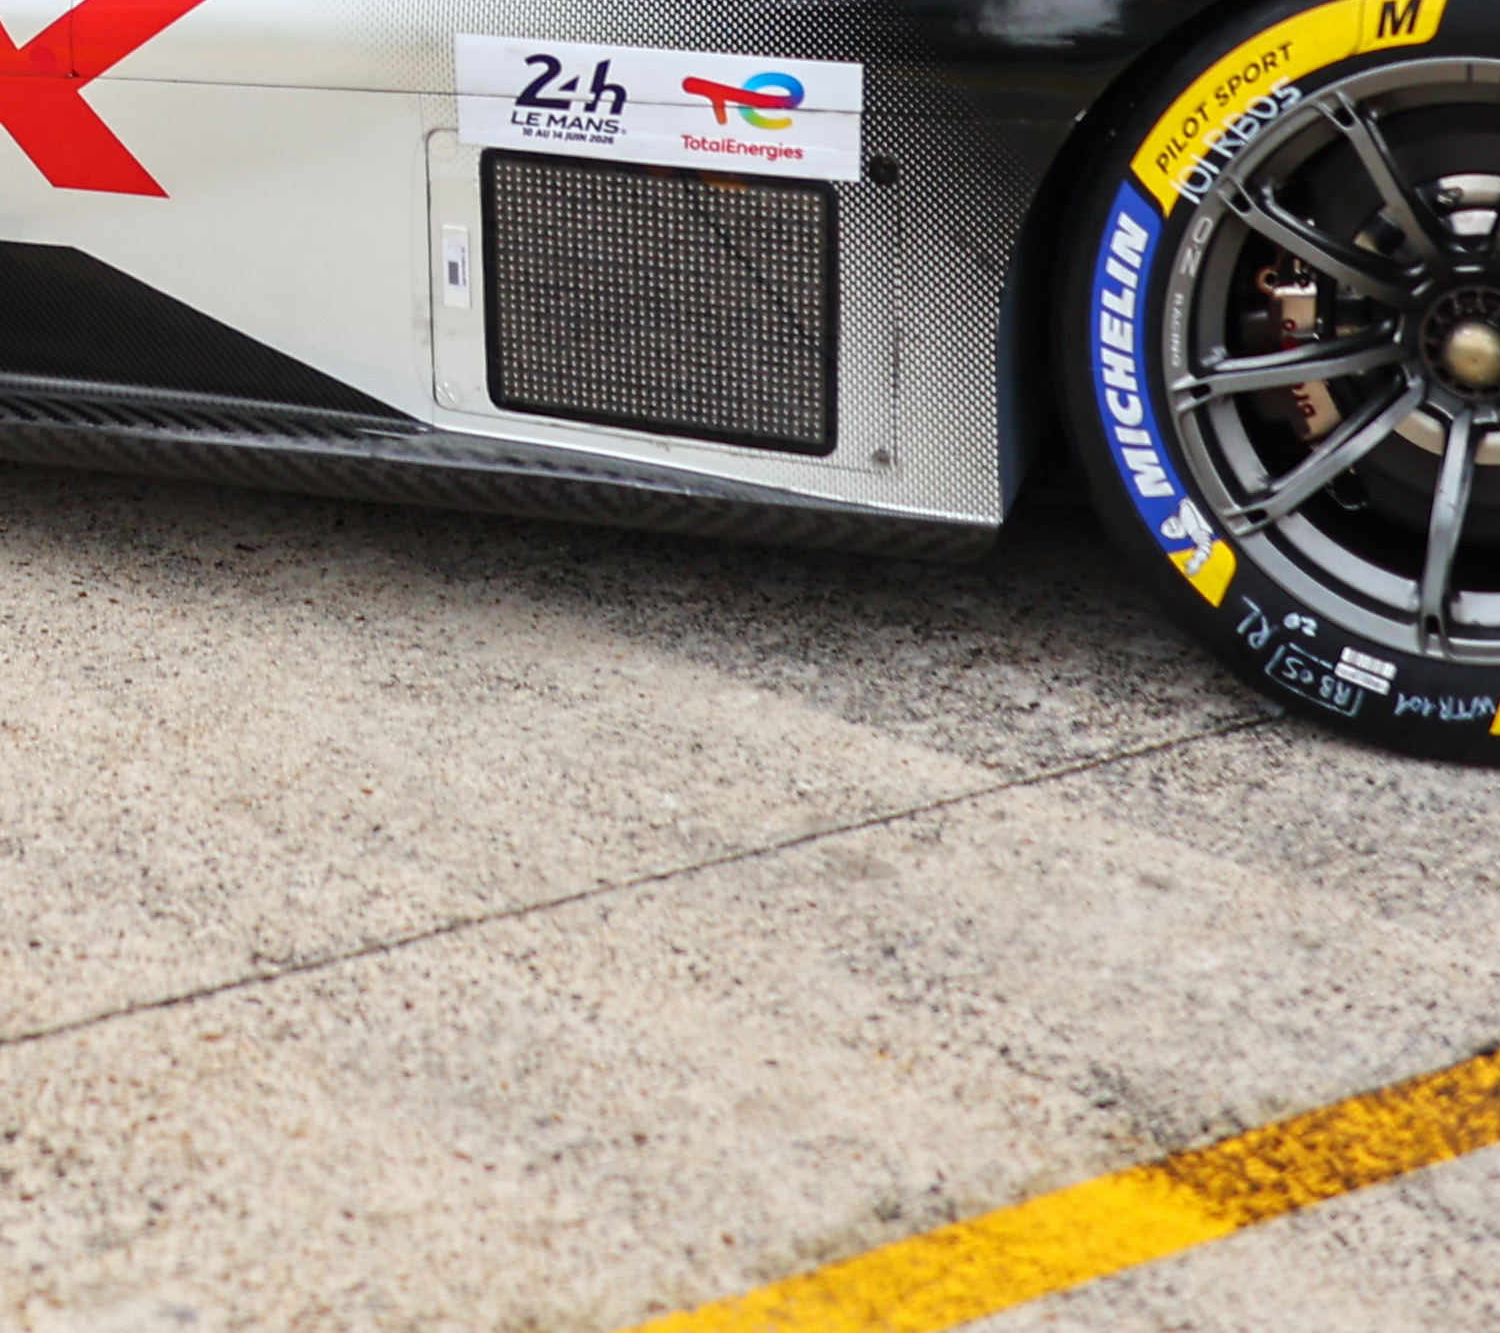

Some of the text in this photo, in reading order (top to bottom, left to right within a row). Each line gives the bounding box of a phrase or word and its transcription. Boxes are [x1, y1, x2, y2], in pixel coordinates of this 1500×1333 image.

[515, 53, 628, 116] 24h
[511, 110, 622, 137] LE MANS
[1156, 42, 1293, 175] PILOT SPORT
[535, 129, 551, 140] AU
[564, 131, 588, 144] JUIN
[681, 134, 804, 162] TotalEnergies
[1100, 210, 1176, 499] MICHELIN
